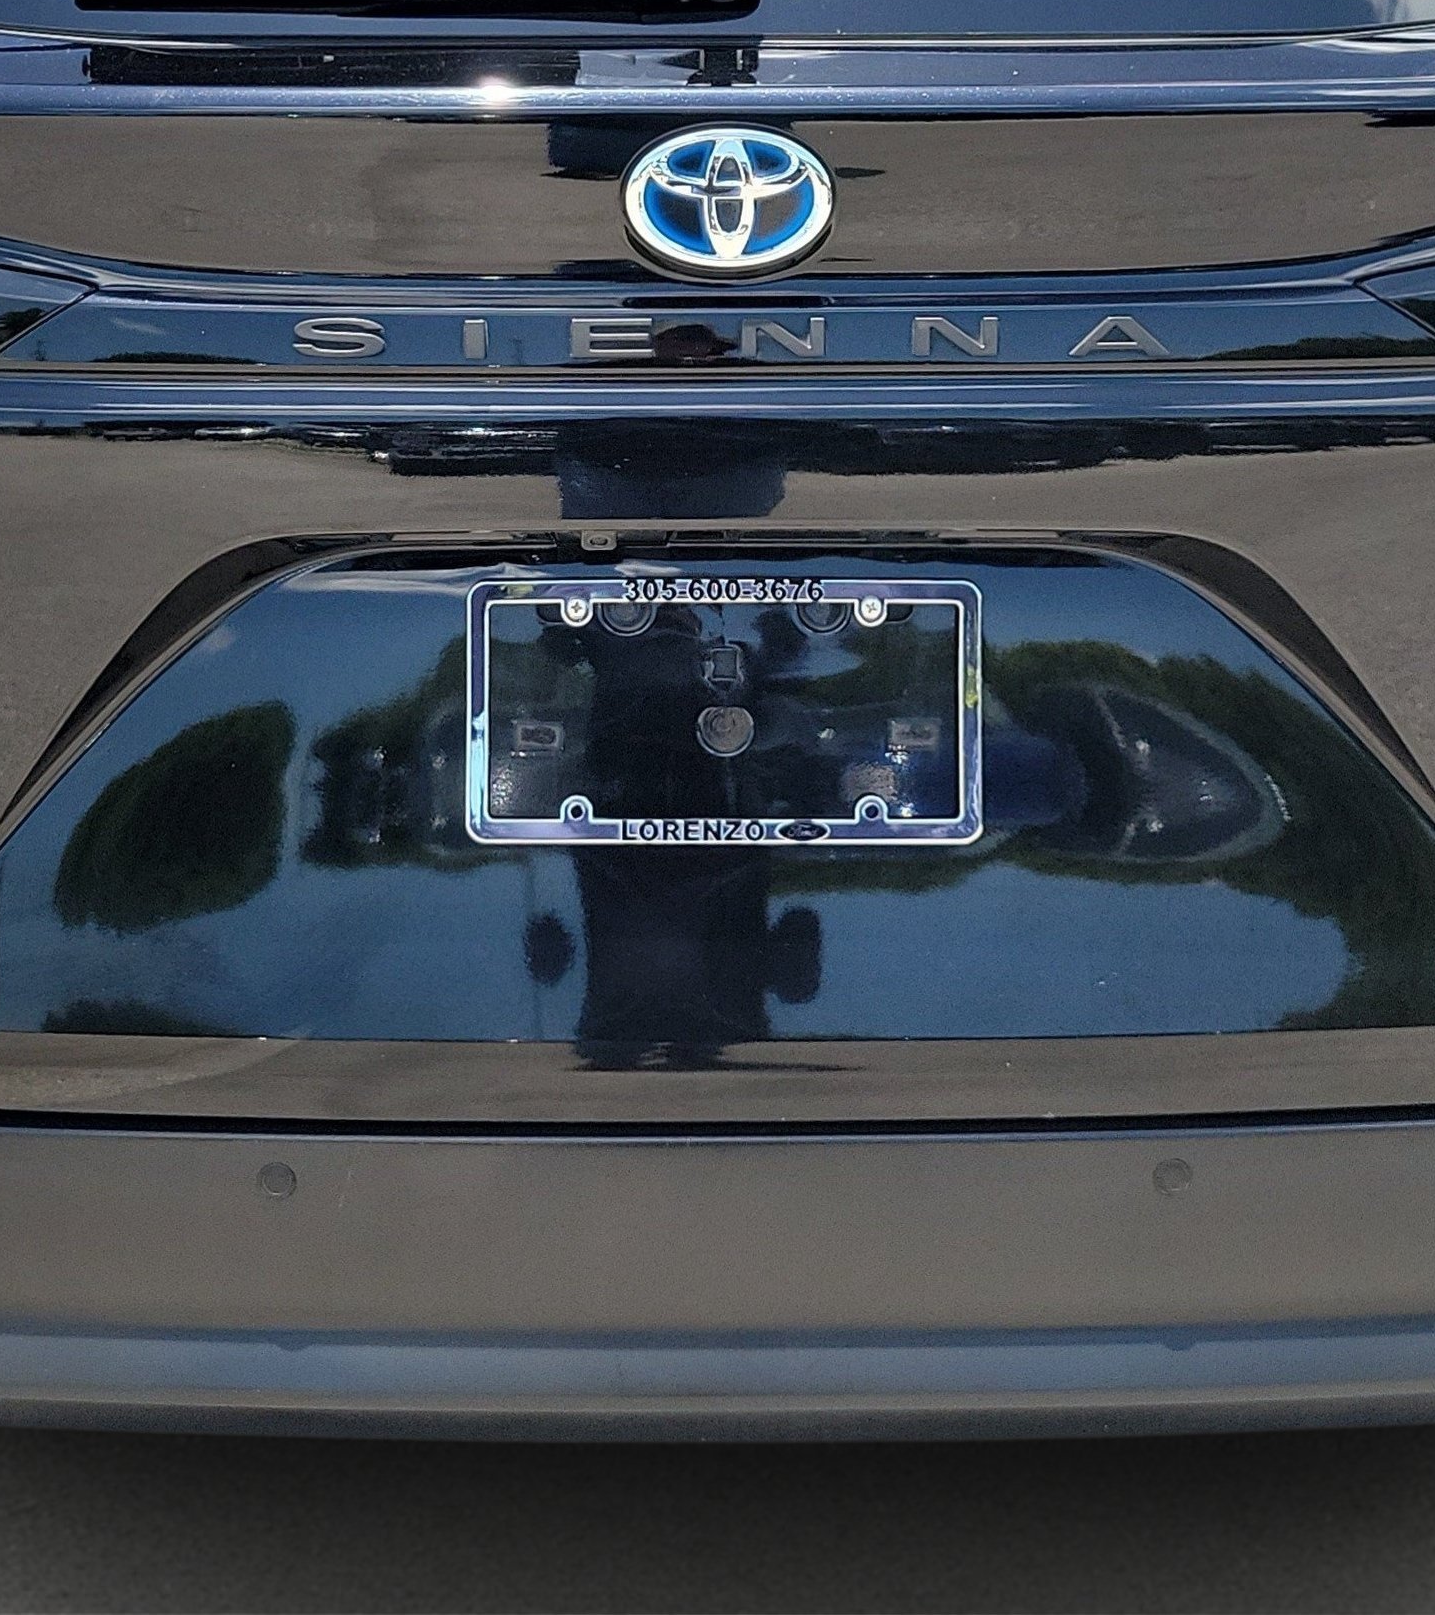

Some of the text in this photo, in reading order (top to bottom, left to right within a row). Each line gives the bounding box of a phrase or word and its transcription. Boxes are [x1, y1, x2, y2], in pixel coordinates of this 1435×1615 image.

[292, 316, 1172, 358] SIENNA
[624, 578, 824, 602] 305-600-3676
[621, 819, 765, 842] LORENZO
